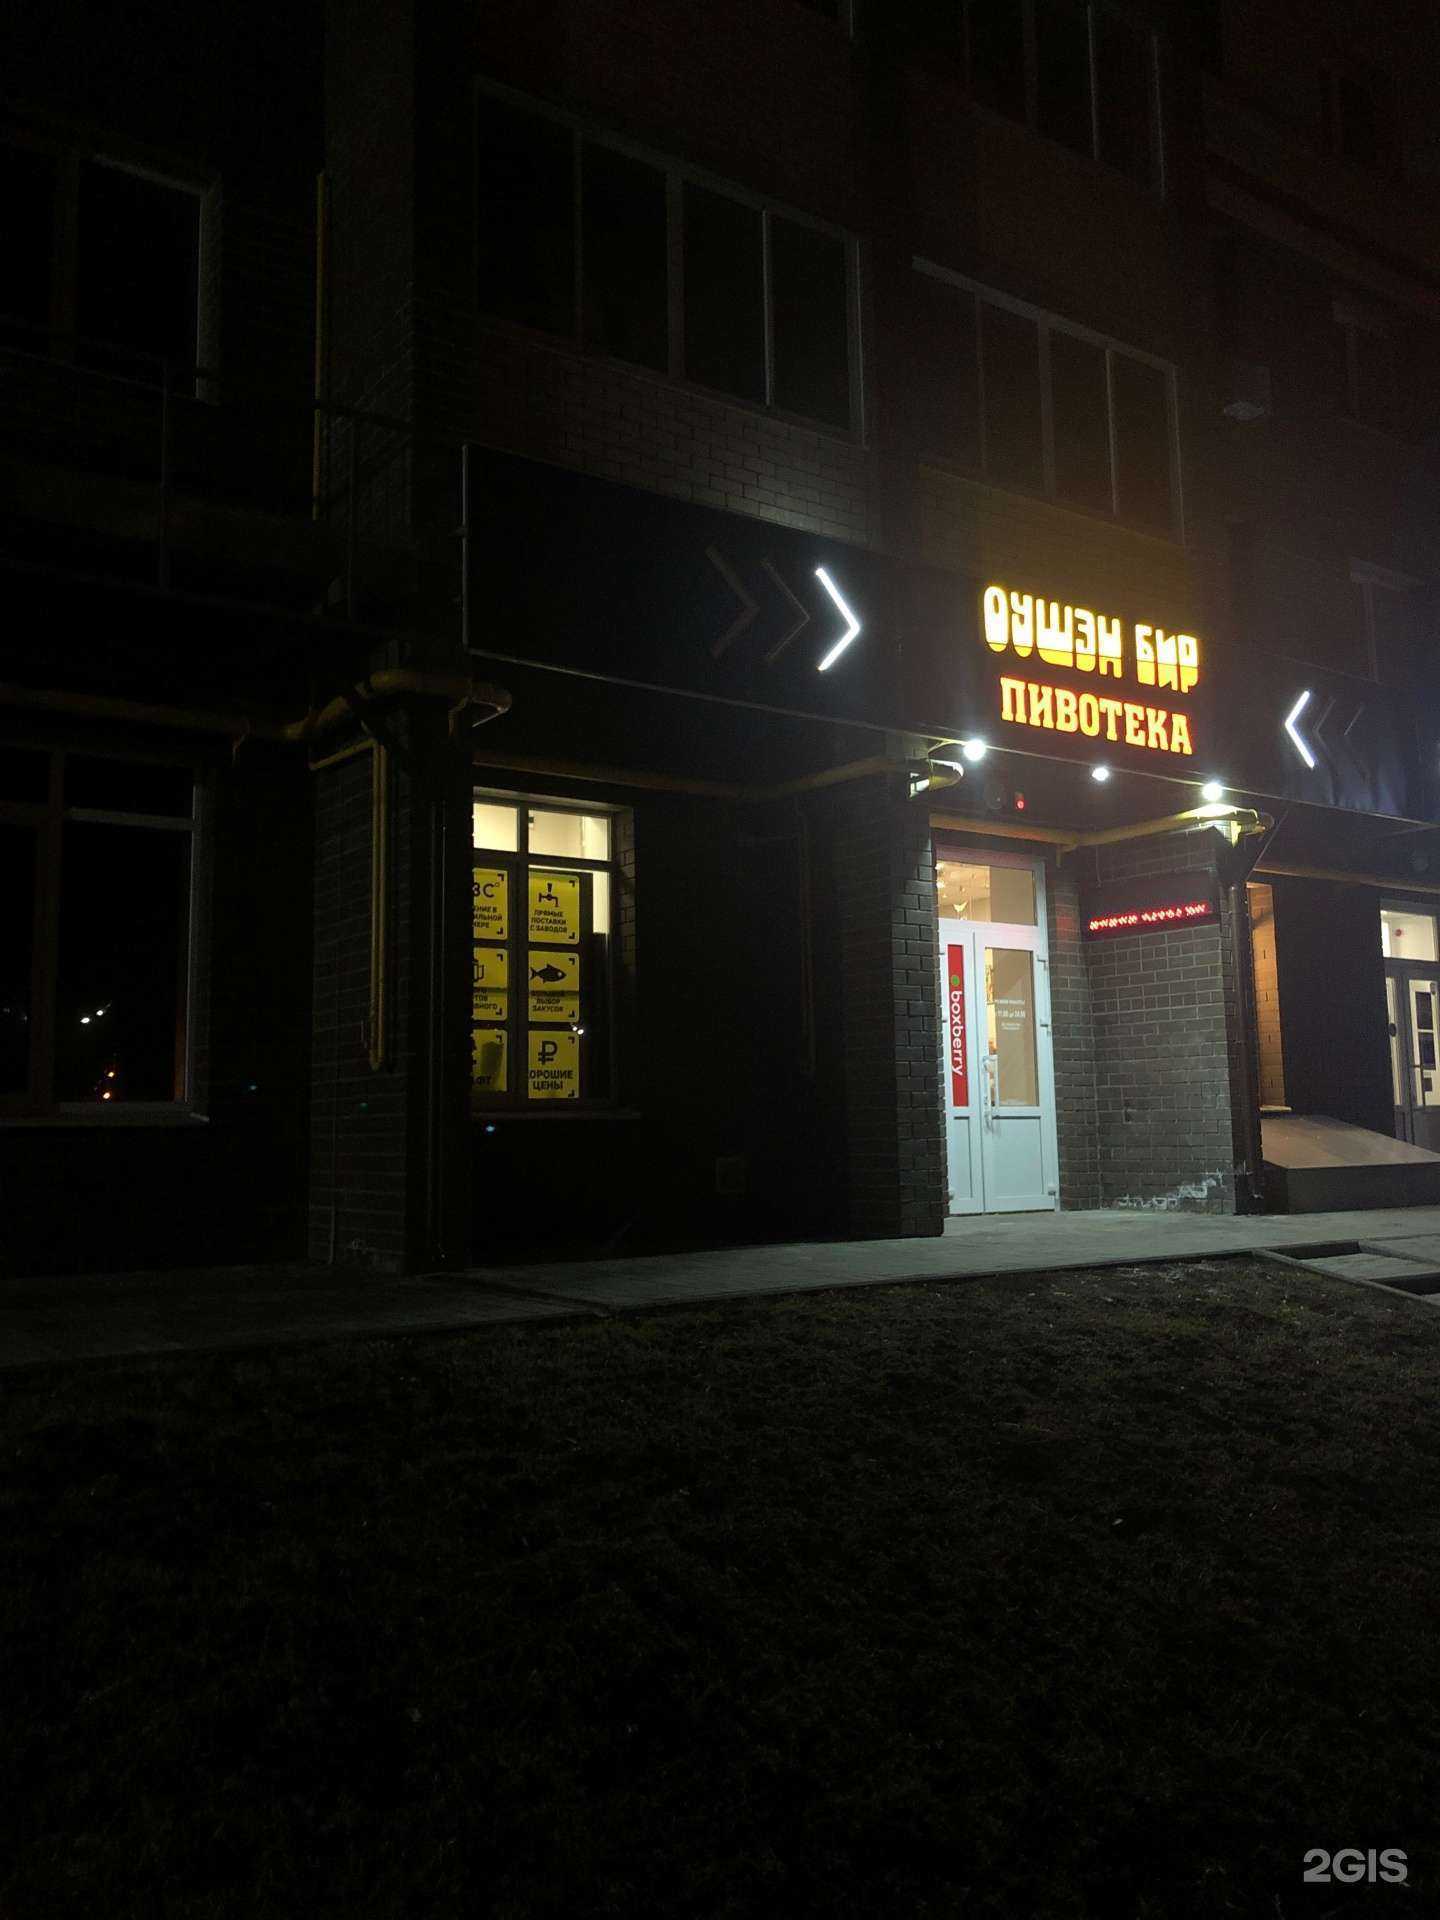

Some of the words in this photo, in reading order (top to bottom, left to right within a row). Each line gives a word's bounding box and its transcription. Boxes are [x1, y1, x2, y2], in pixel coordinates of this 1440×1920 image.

[984, 586, 1123, 679] ОУШЭН
[1135, 623, 1199, 694] БИР
[1000, 676, 1193, 756] ПИВОТЕКА
[531, 917, 567, 925] ПОСТАВКИ
[536, 925, 568, 933] ЗАВОДОВ
[950, 990, 964, 1077] boxberry
[528, 1069, 574, 1080] ОРОШИЕ
[533, 1080, 564, 1091] ЦЕНЫ
